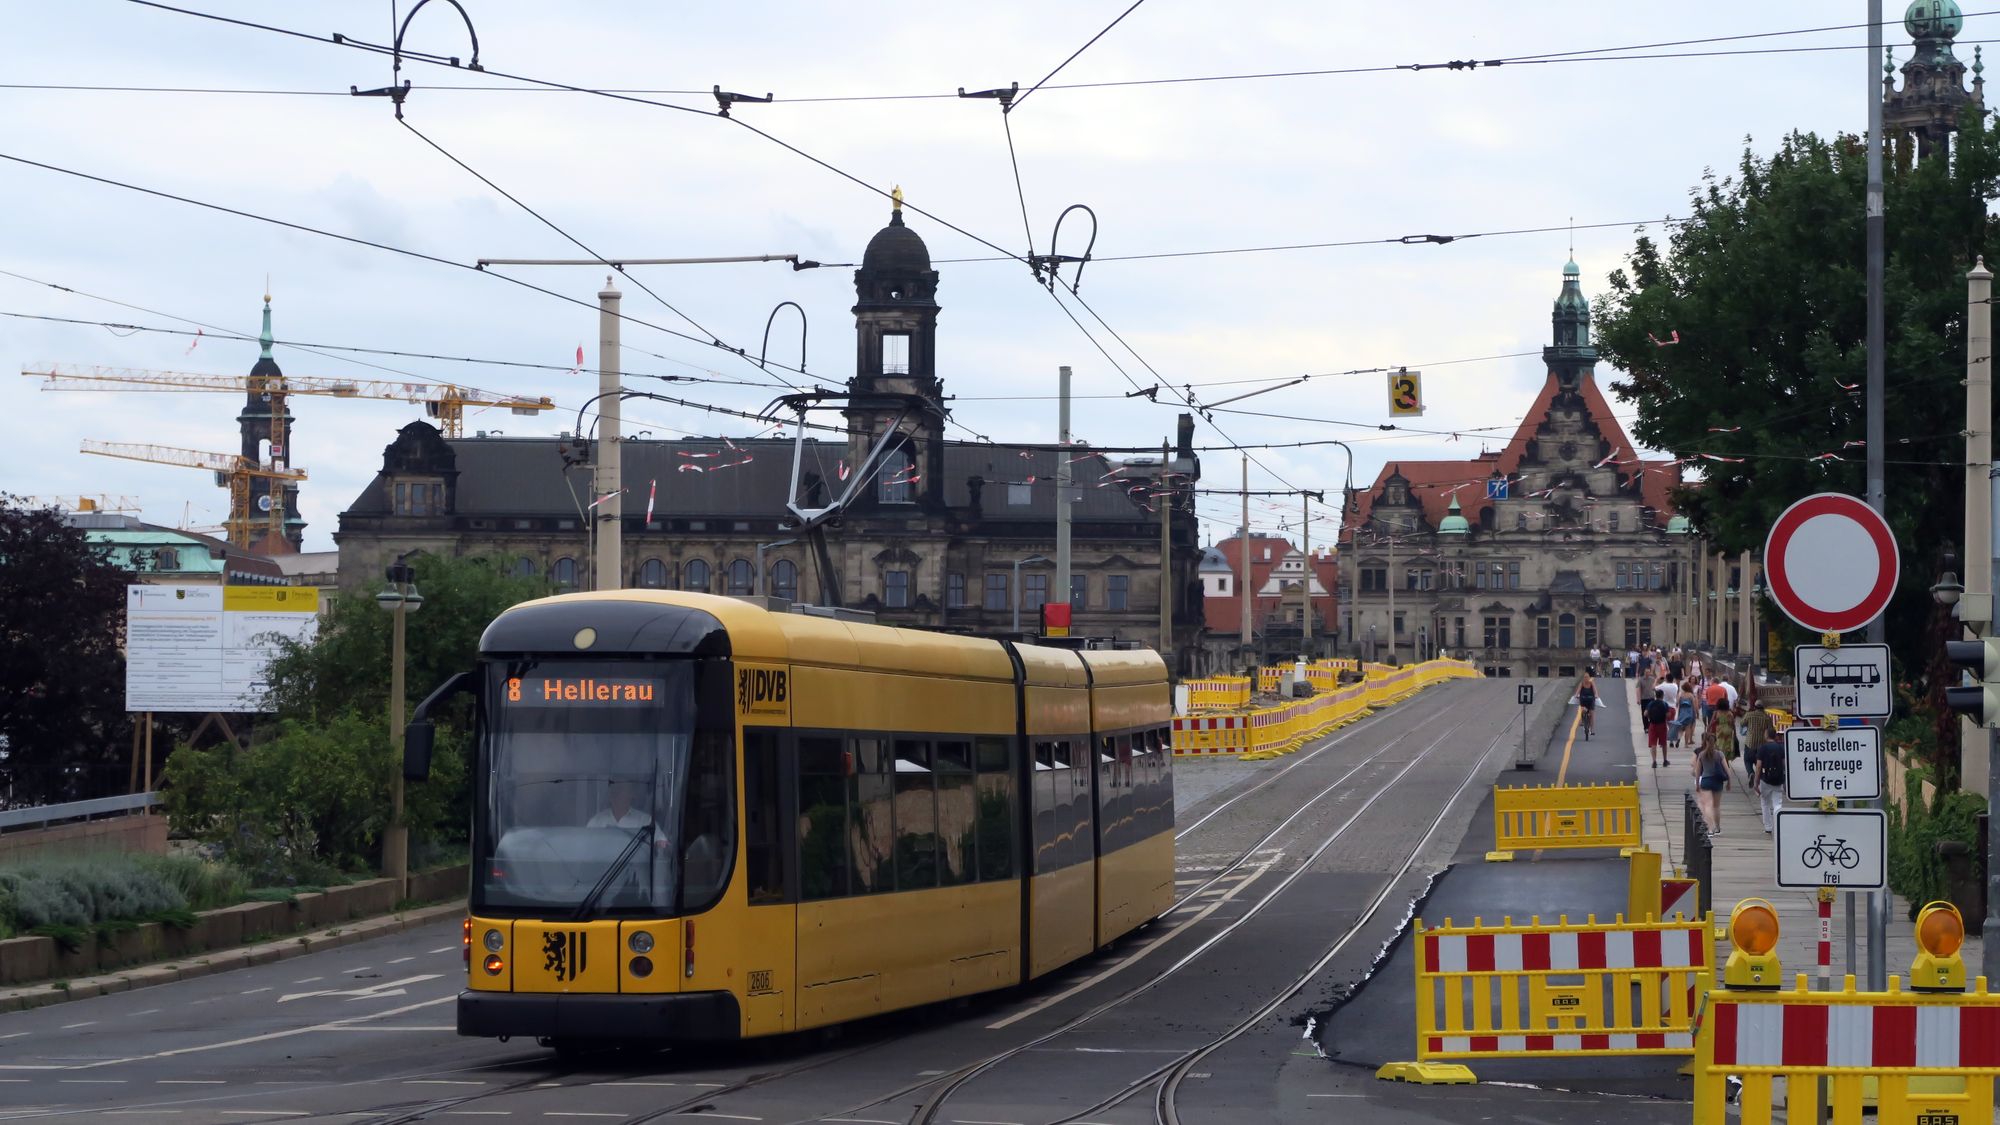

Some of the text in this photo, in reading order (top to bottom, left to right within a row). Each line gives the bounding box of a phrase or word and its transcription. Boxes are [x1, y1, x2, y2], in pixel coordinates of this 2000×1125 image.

[1394, 379, 1418, 410] 3
[508, 678, 654, 702] 8 Hellerau
[755, 669, 787, 702] DVB
[1520, 686, 1532, 703] H
[1830, 692, 1859, 707] frei
[1797, 737, 1867, 753] Baustellen-
[1803, 757, 1863, 774] fahrzeuge
[1820, 775, 1848, 791] frei
[1823, 871, 1841, 884] frei
[751, 972, 770, 990] 2606
